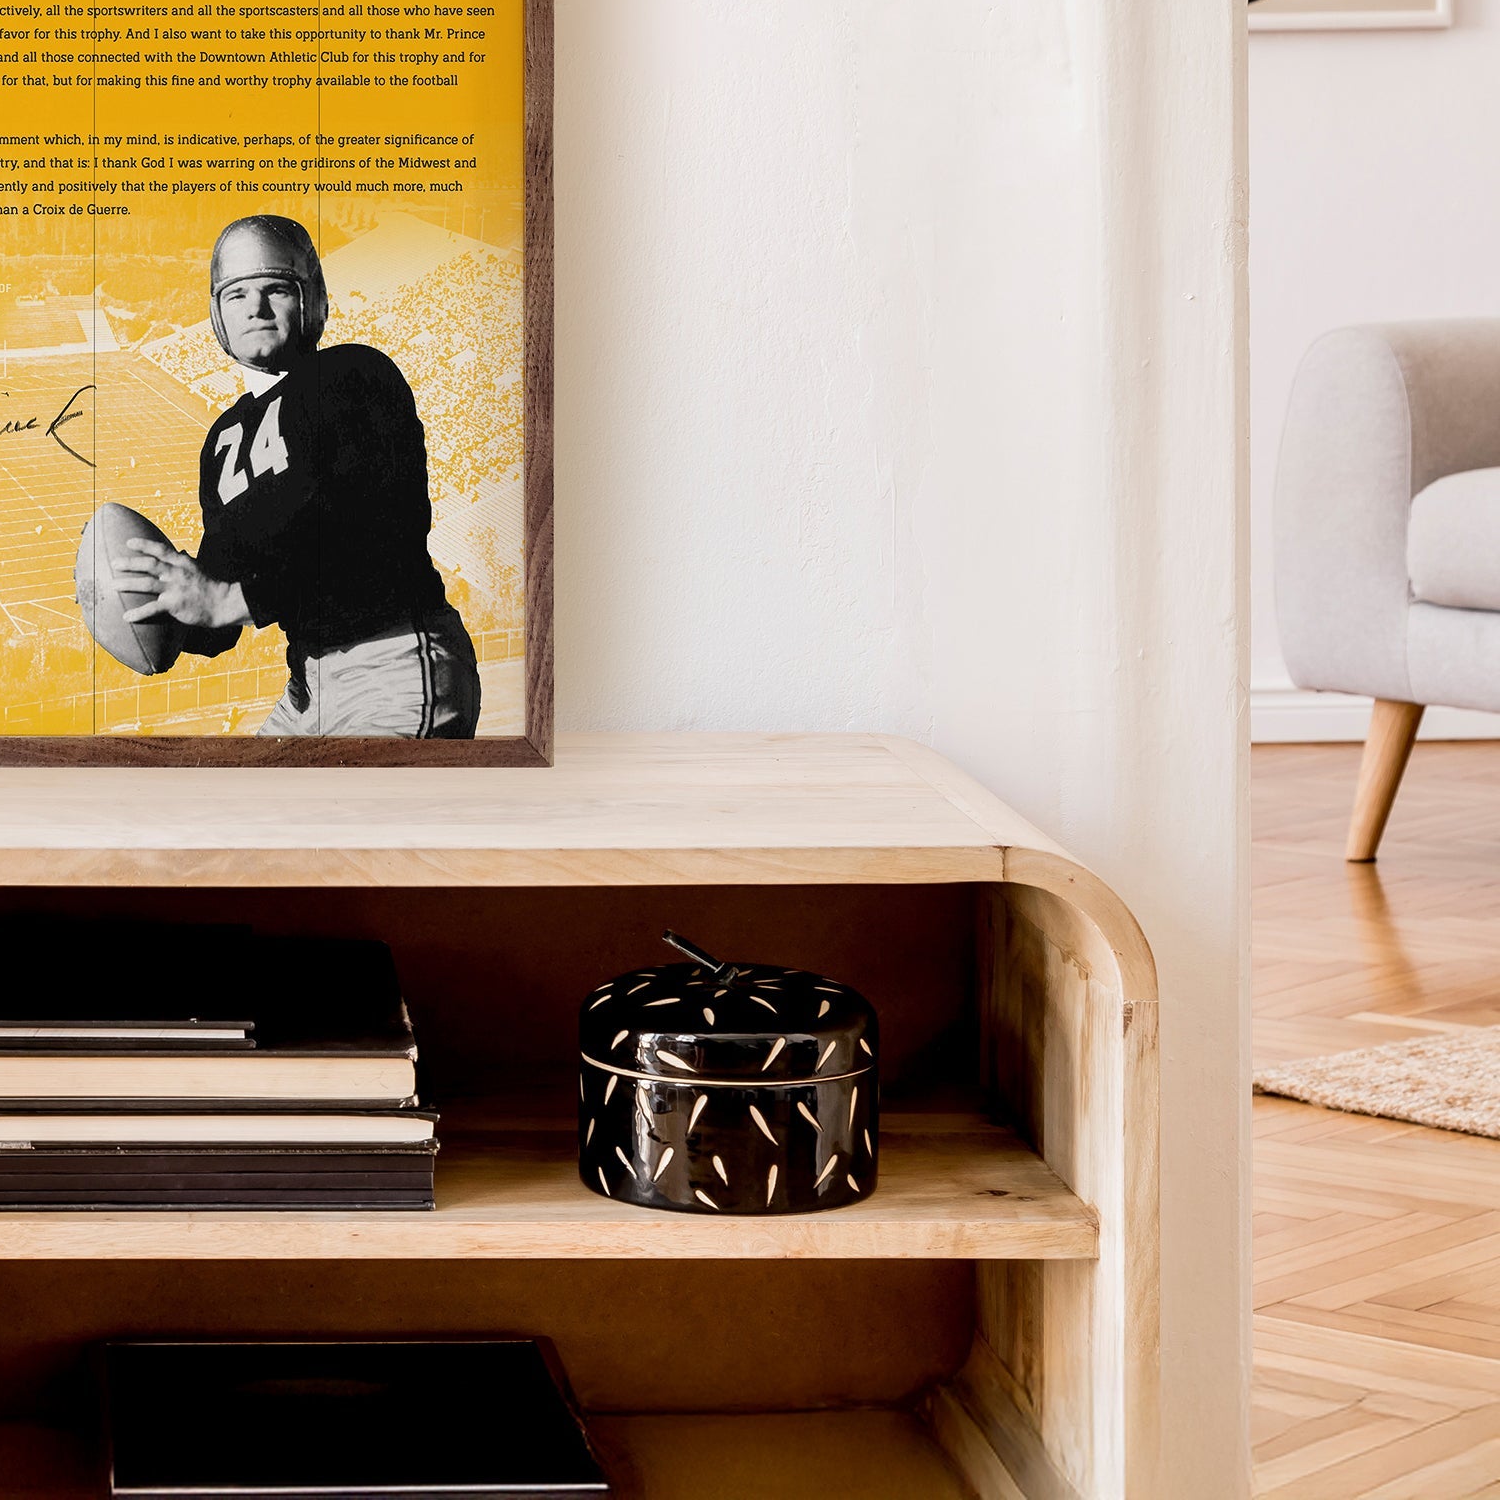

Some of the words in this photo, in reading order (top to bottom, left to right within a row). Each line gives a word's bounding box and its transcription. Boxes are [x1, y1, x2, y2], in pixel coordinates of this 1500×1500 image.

[1, 74, 19, 86] for
[21, 74, 49, 87] that,
[52, 74, 73, 87] but
[75, 74, 93, 87] for
[96, 74, 142, 91] making
[144, 74, 168, 87] this
[171, 74, 195, 87] fine
[197, 74, 222, 87] and
[224, 74, 269, 90] worthy
[272, 74, 313, 89] trophy
[315, 74, 371, 87] available
[373, 75, 386, 87] to
[388, 74, 409, 87] the
[412, 74, 459, 87] football
[21, 206, 30, 216] a
[32, 203, 66, 216] Croix
[68, 203, 84, 216] de
[86, 203, 131, 216] Guerre.
[214, 395, 289, 506] 24
